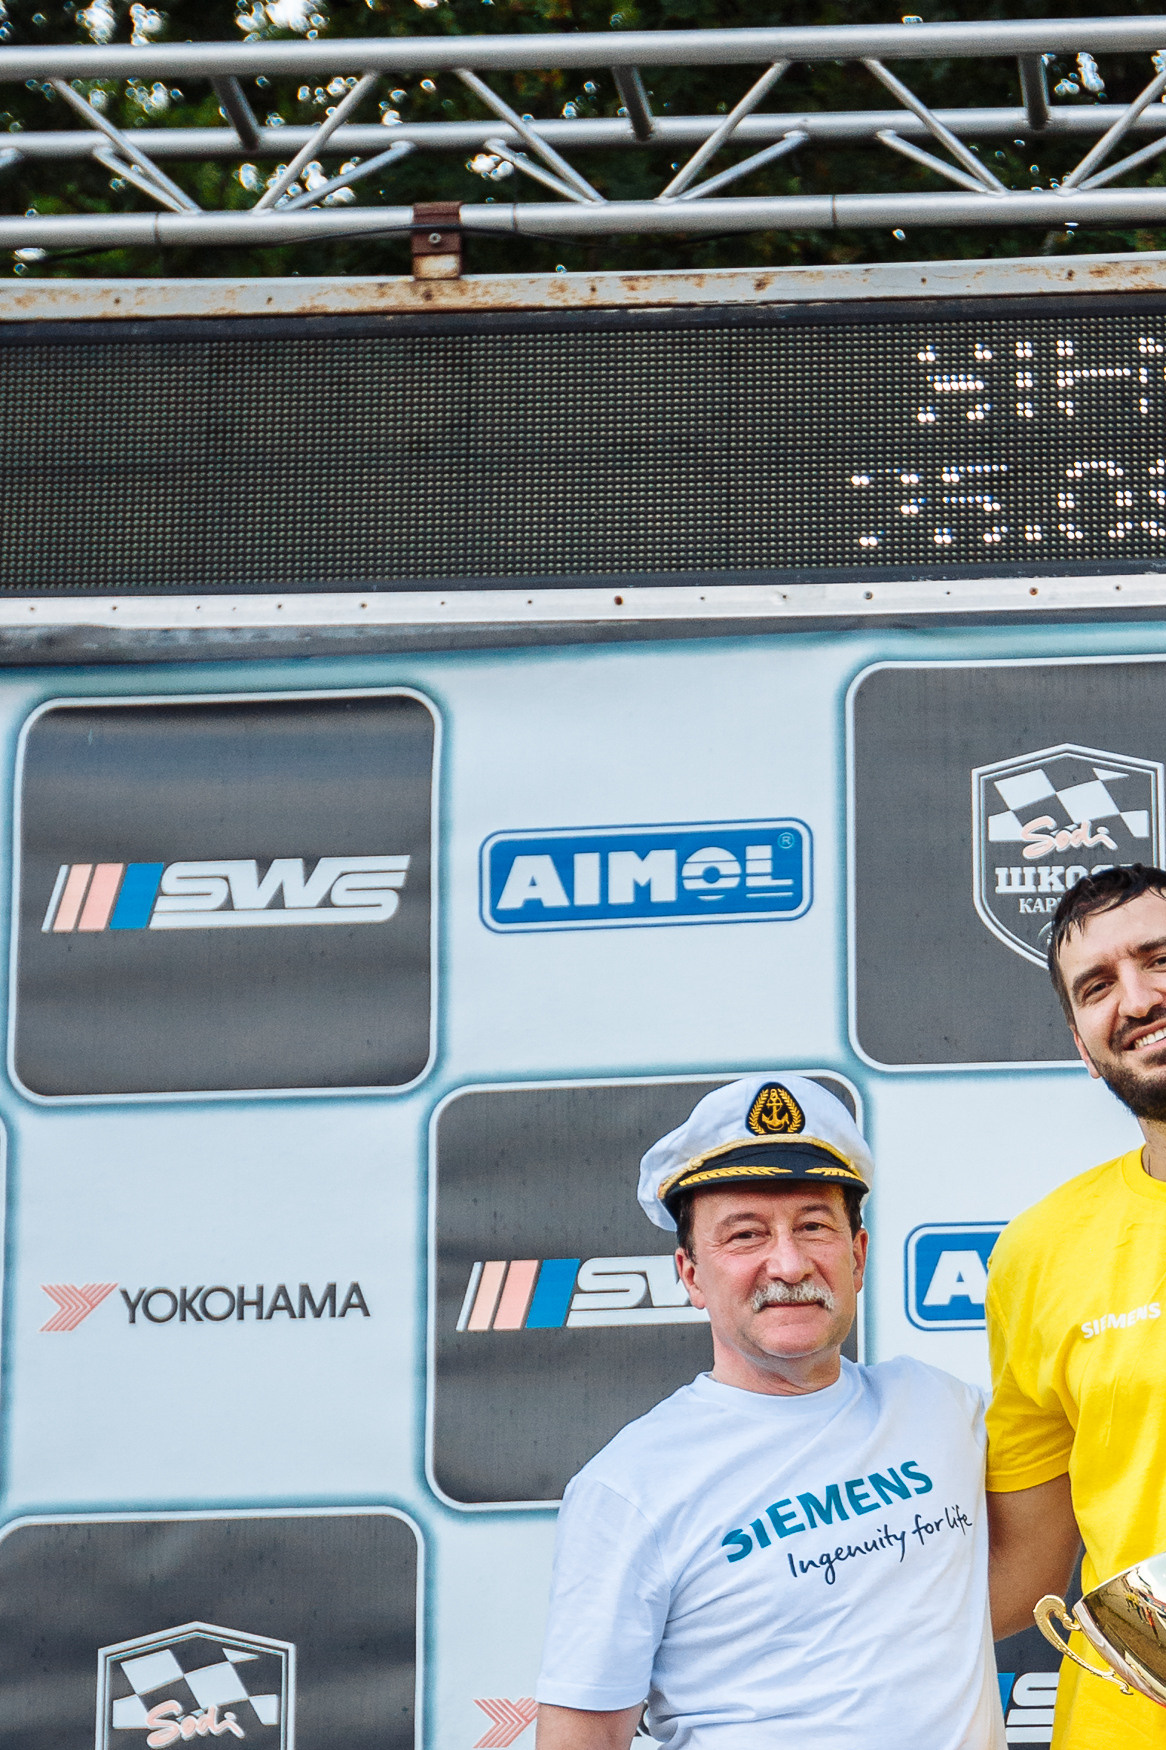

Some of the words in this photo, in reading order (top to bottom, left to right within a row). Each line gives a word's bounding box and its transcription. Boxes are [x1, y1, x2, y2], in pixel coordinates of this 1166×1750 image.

[1021, 815, 1118, 860] Sodi
[149, 855, 411, 929] SWS
[496, 844, 794, 910] AIMOL
[995, 864, 1132, 893] ШКО
[119, 1281, 371, 1324] YOKOHAMA
[1081, 1302, 1161, 1339] SIEMENS
[721, 1460, 933, 1563] SIEMENS
[787, 1524, 906, 1585] Ingenuity
[911, 1514, 944, 1546] for
[944, 1504, 973, 1536] life
[146, 1699, 245, 1749] Sodi
